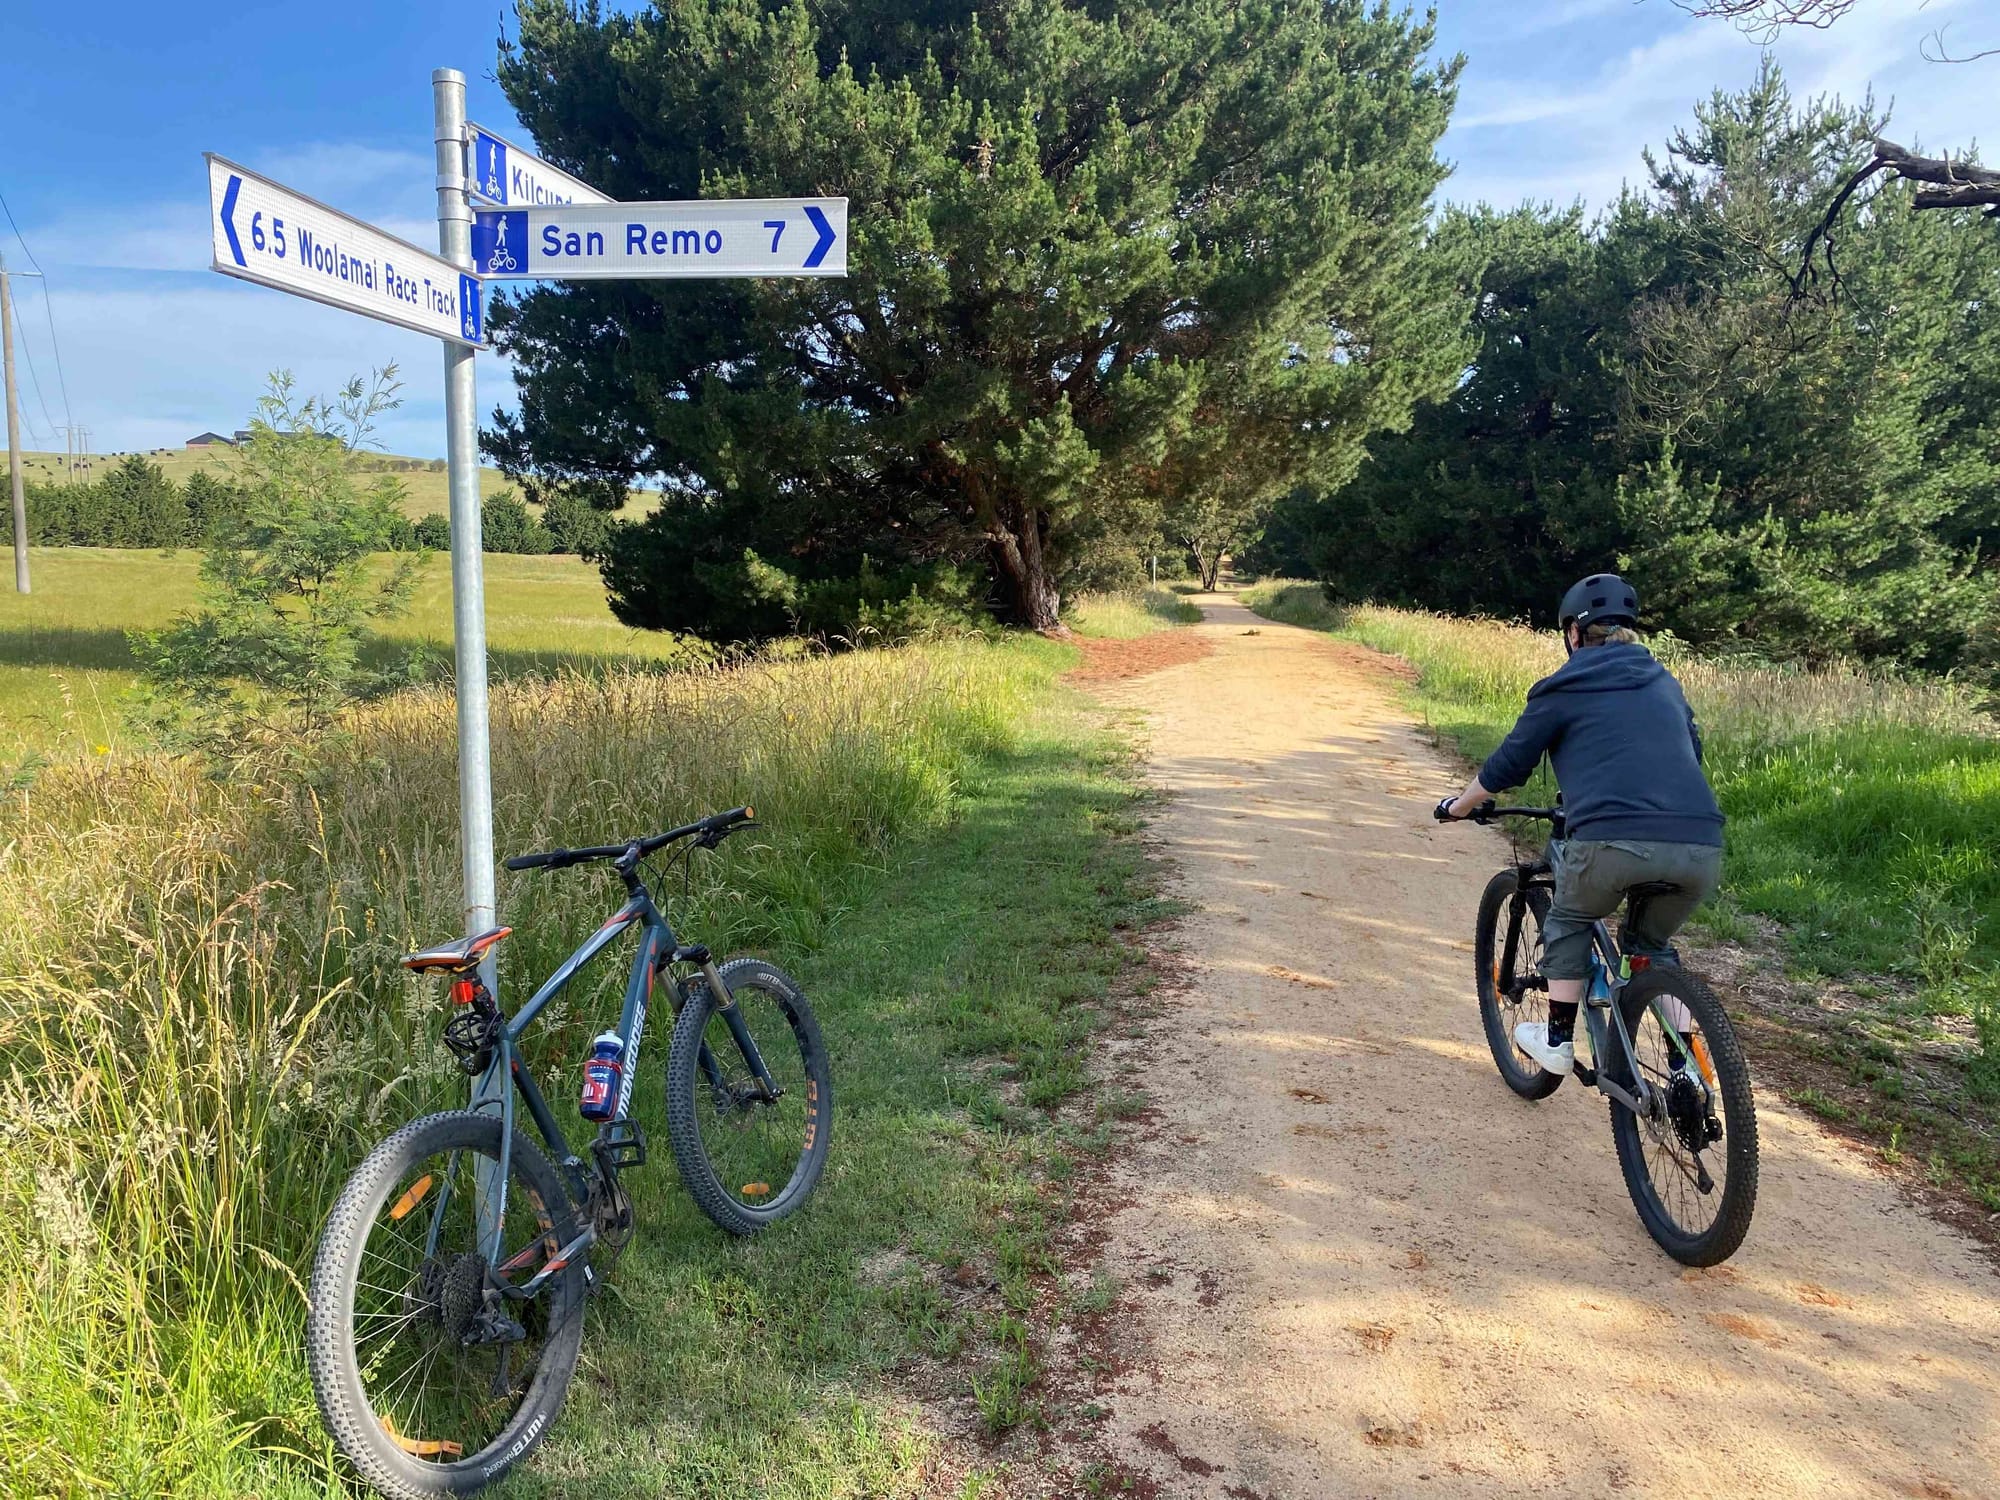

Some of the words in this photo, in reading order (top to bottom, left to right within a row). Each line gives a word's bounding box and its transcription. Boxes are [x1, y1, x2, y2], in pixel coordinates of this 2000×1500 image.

[252, 211, 286, 258] 6.5
[298, 227, 378, 291] Woolamai
[385, 262, 418, 304] Race
[424, 278, 457, 318] Track
[542, 224, 604, 256] San
[626, 223, 723, 256] Remo
[763, 220, 786, 254] 7
[617, 1000, 646, 1120] MONGOOSE
[511, 1418, 542, 1457] WTB
